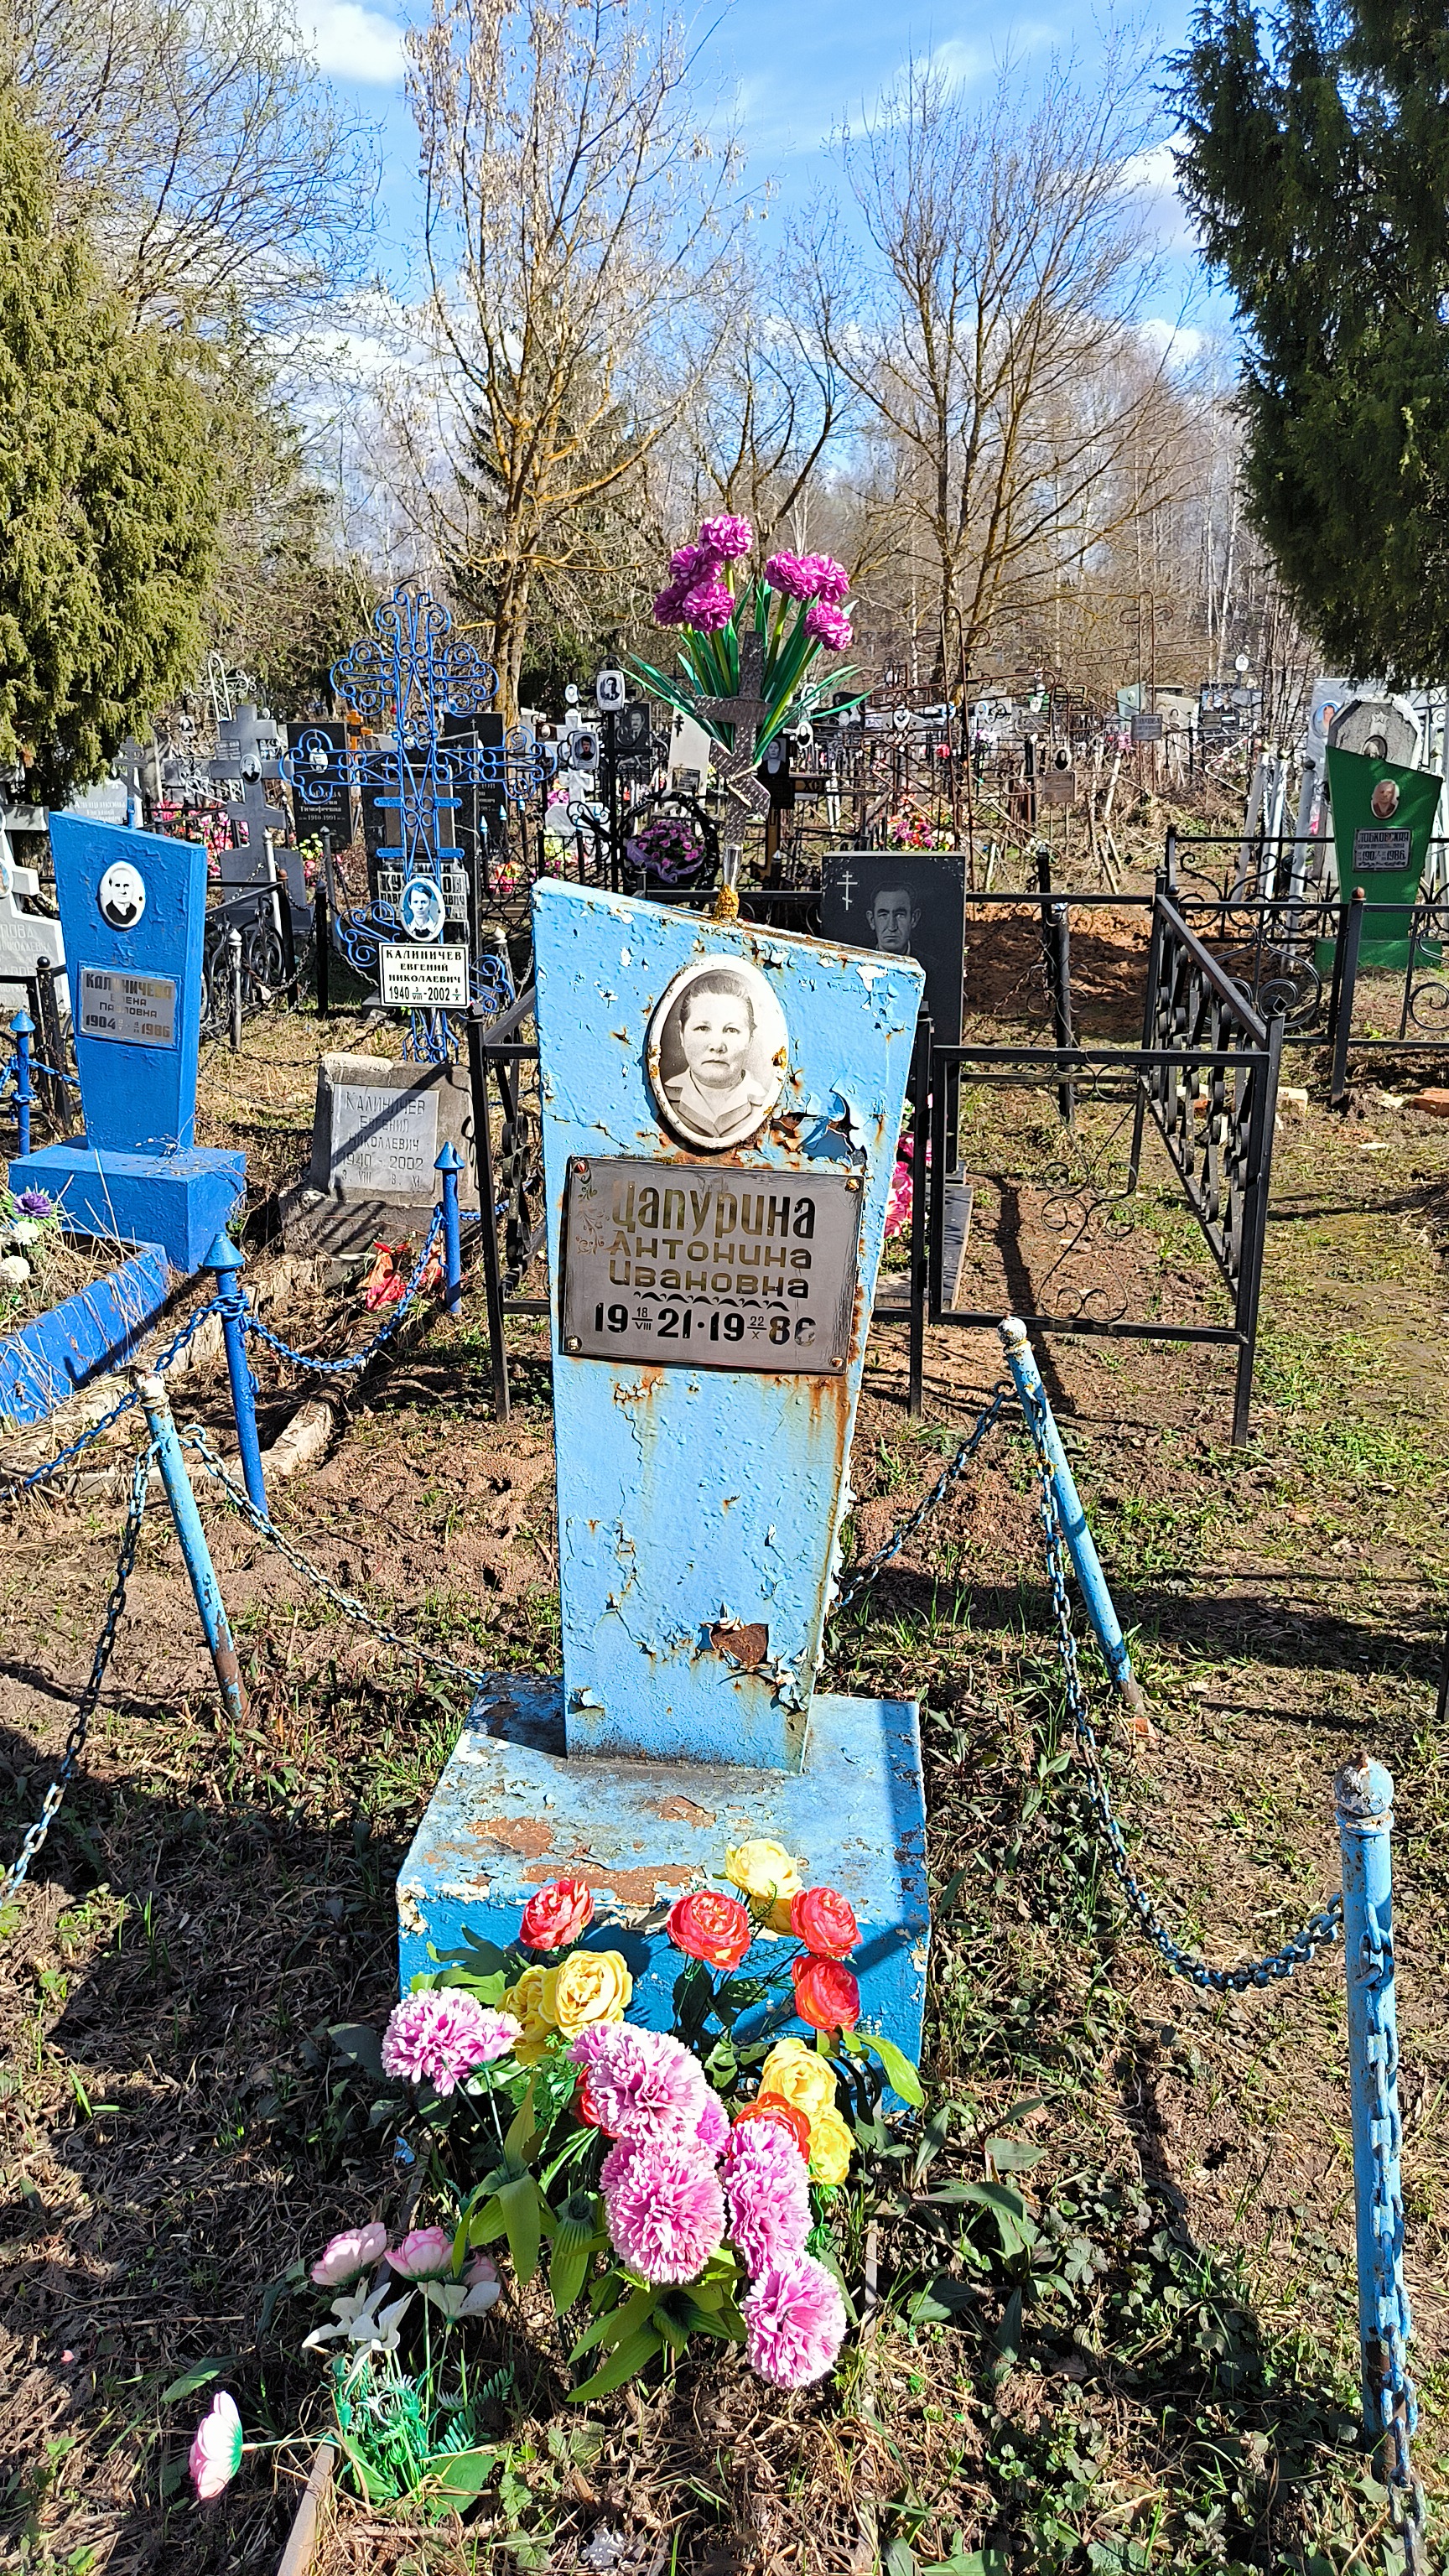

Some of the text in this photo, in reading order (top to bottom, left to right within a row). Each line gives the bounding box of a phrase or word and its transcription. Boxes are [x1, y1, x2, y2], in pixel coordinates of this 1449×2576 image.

[386, 949, 462, 961] КАЛИНИЧЕВ
[400, 963, 449, 972] ЕВГЕНИЙ
[388, 974, 461, 984] НИКОЛАЕВИЧ
[389, 985, 410, 1000] 1940
[428, 986, 450, 1001] 2002
[86, 1015, 116, 1030] 1904
[141, 1023, 170, 1038] 1986
[342, 1152, 372, 1168] 1940
[389, 1156, 423, 1171] 2002
